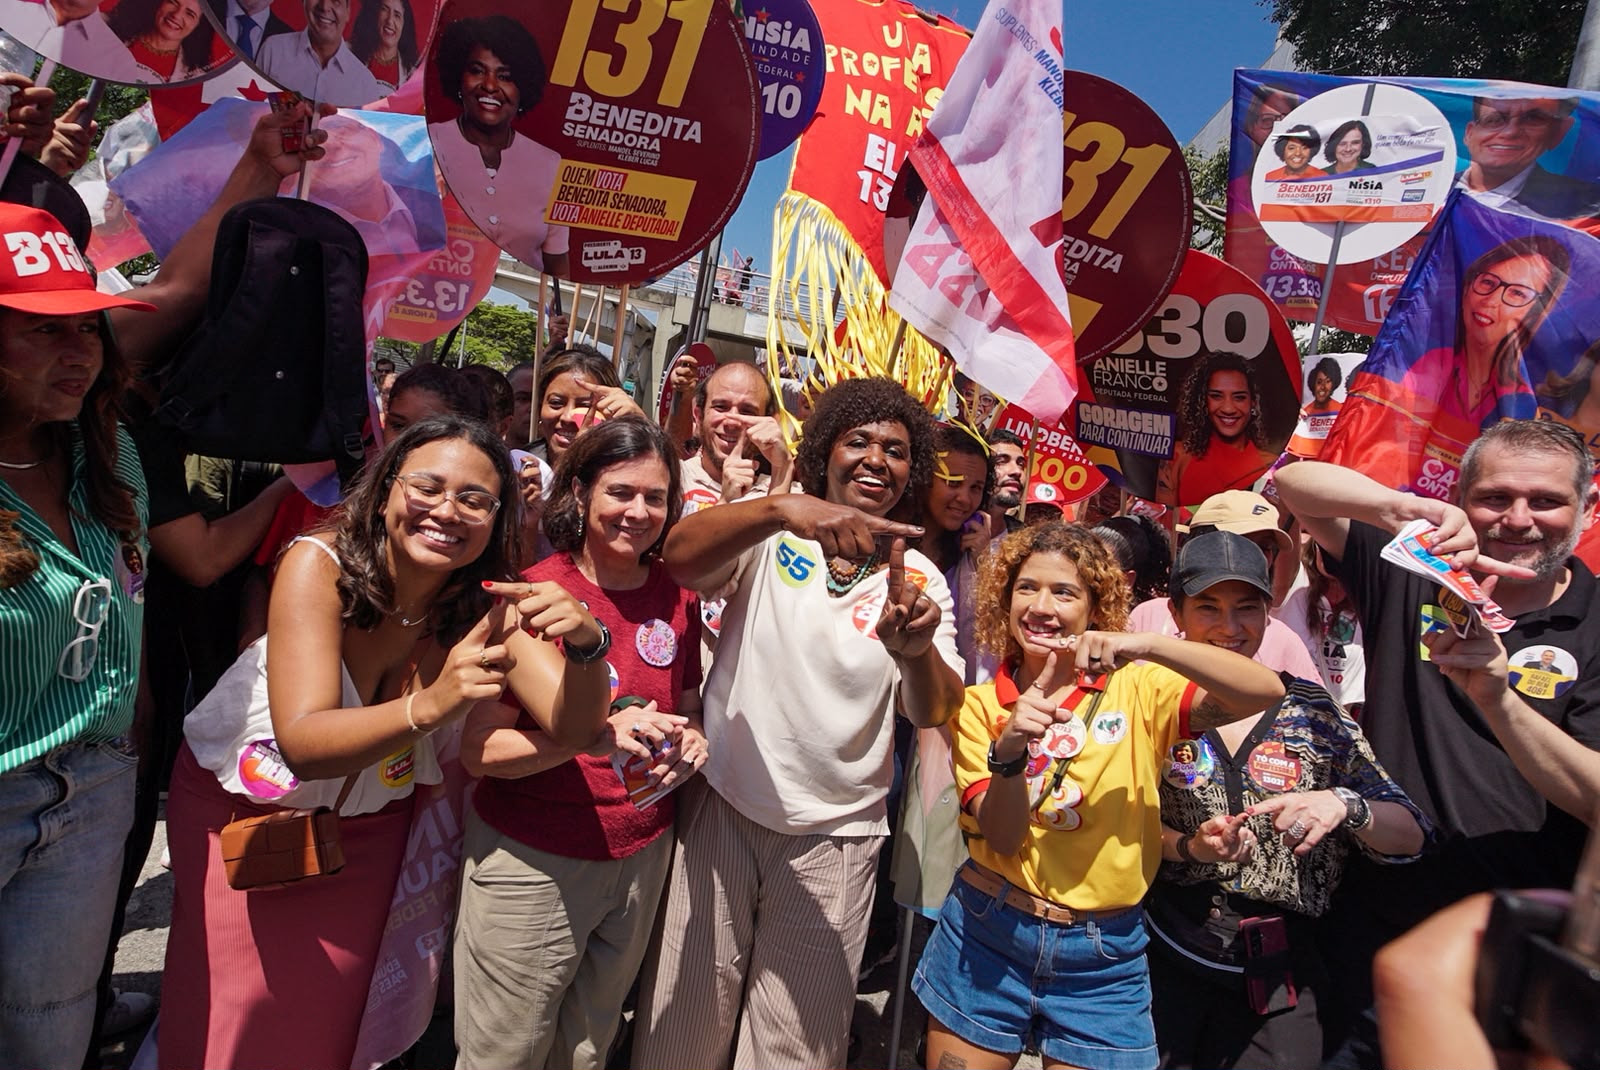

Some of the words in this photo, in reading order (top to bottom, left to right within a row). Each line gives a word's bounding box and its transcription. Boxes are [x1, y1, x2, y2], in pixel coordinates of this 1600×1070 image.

[995, 7, 1038, 55] SUPLENTES:
[1034, 49, 1064, 92] MANO
[755, 62, 794, 80] EDERAL
[758, 79, 802, 119] 10
[844, 83, 892, 130] NA
[565, 91, 702, 144] BENEDITA
[562, 121, 661, 153] SENADORA
[617, 153, 640, 164] KLEBER
[639, 157, 658, 167] LUCAS
[561, 165, 596, 186] QUEM
[595, 170, 625, 190] VOTA
[1063, 112, 1172, 240] 31
[1278, 183, 1333, 194] BENEDITA
[556, 184, 610, 208] BENEDITA
[609, 192, 668, 218] SENADORA,
[1314, 192, 1332, 203] 131
[551, 202, 581, 223] VOTA
[579, 207, 623, 229] ANIELLE
[621, 213, 680, 237] DEPUTADA!
[583, 249, 625, 261] LULA
[630, 248, 642, 260] 13
[1264, 275, 1321, 298] 13.333
[1093, 357, 1167, 377] ANIELLE
[1093, 370, 1168, 392] FRANCO
[1094, 388, 1132, 398] DEPUTADA
[1133, 392, 1168, 403] FEDERAL
[1078, 402, 1171, 437] CORAGEM
[1079, 422, 1105, 444] PARA
[1107, 428, 1171, 455] CONTINUAR
[775, 541, 816, 582] 55
[1268, 757, 1288, 767] COM
[1262, 775, 1286, 787] 13021
